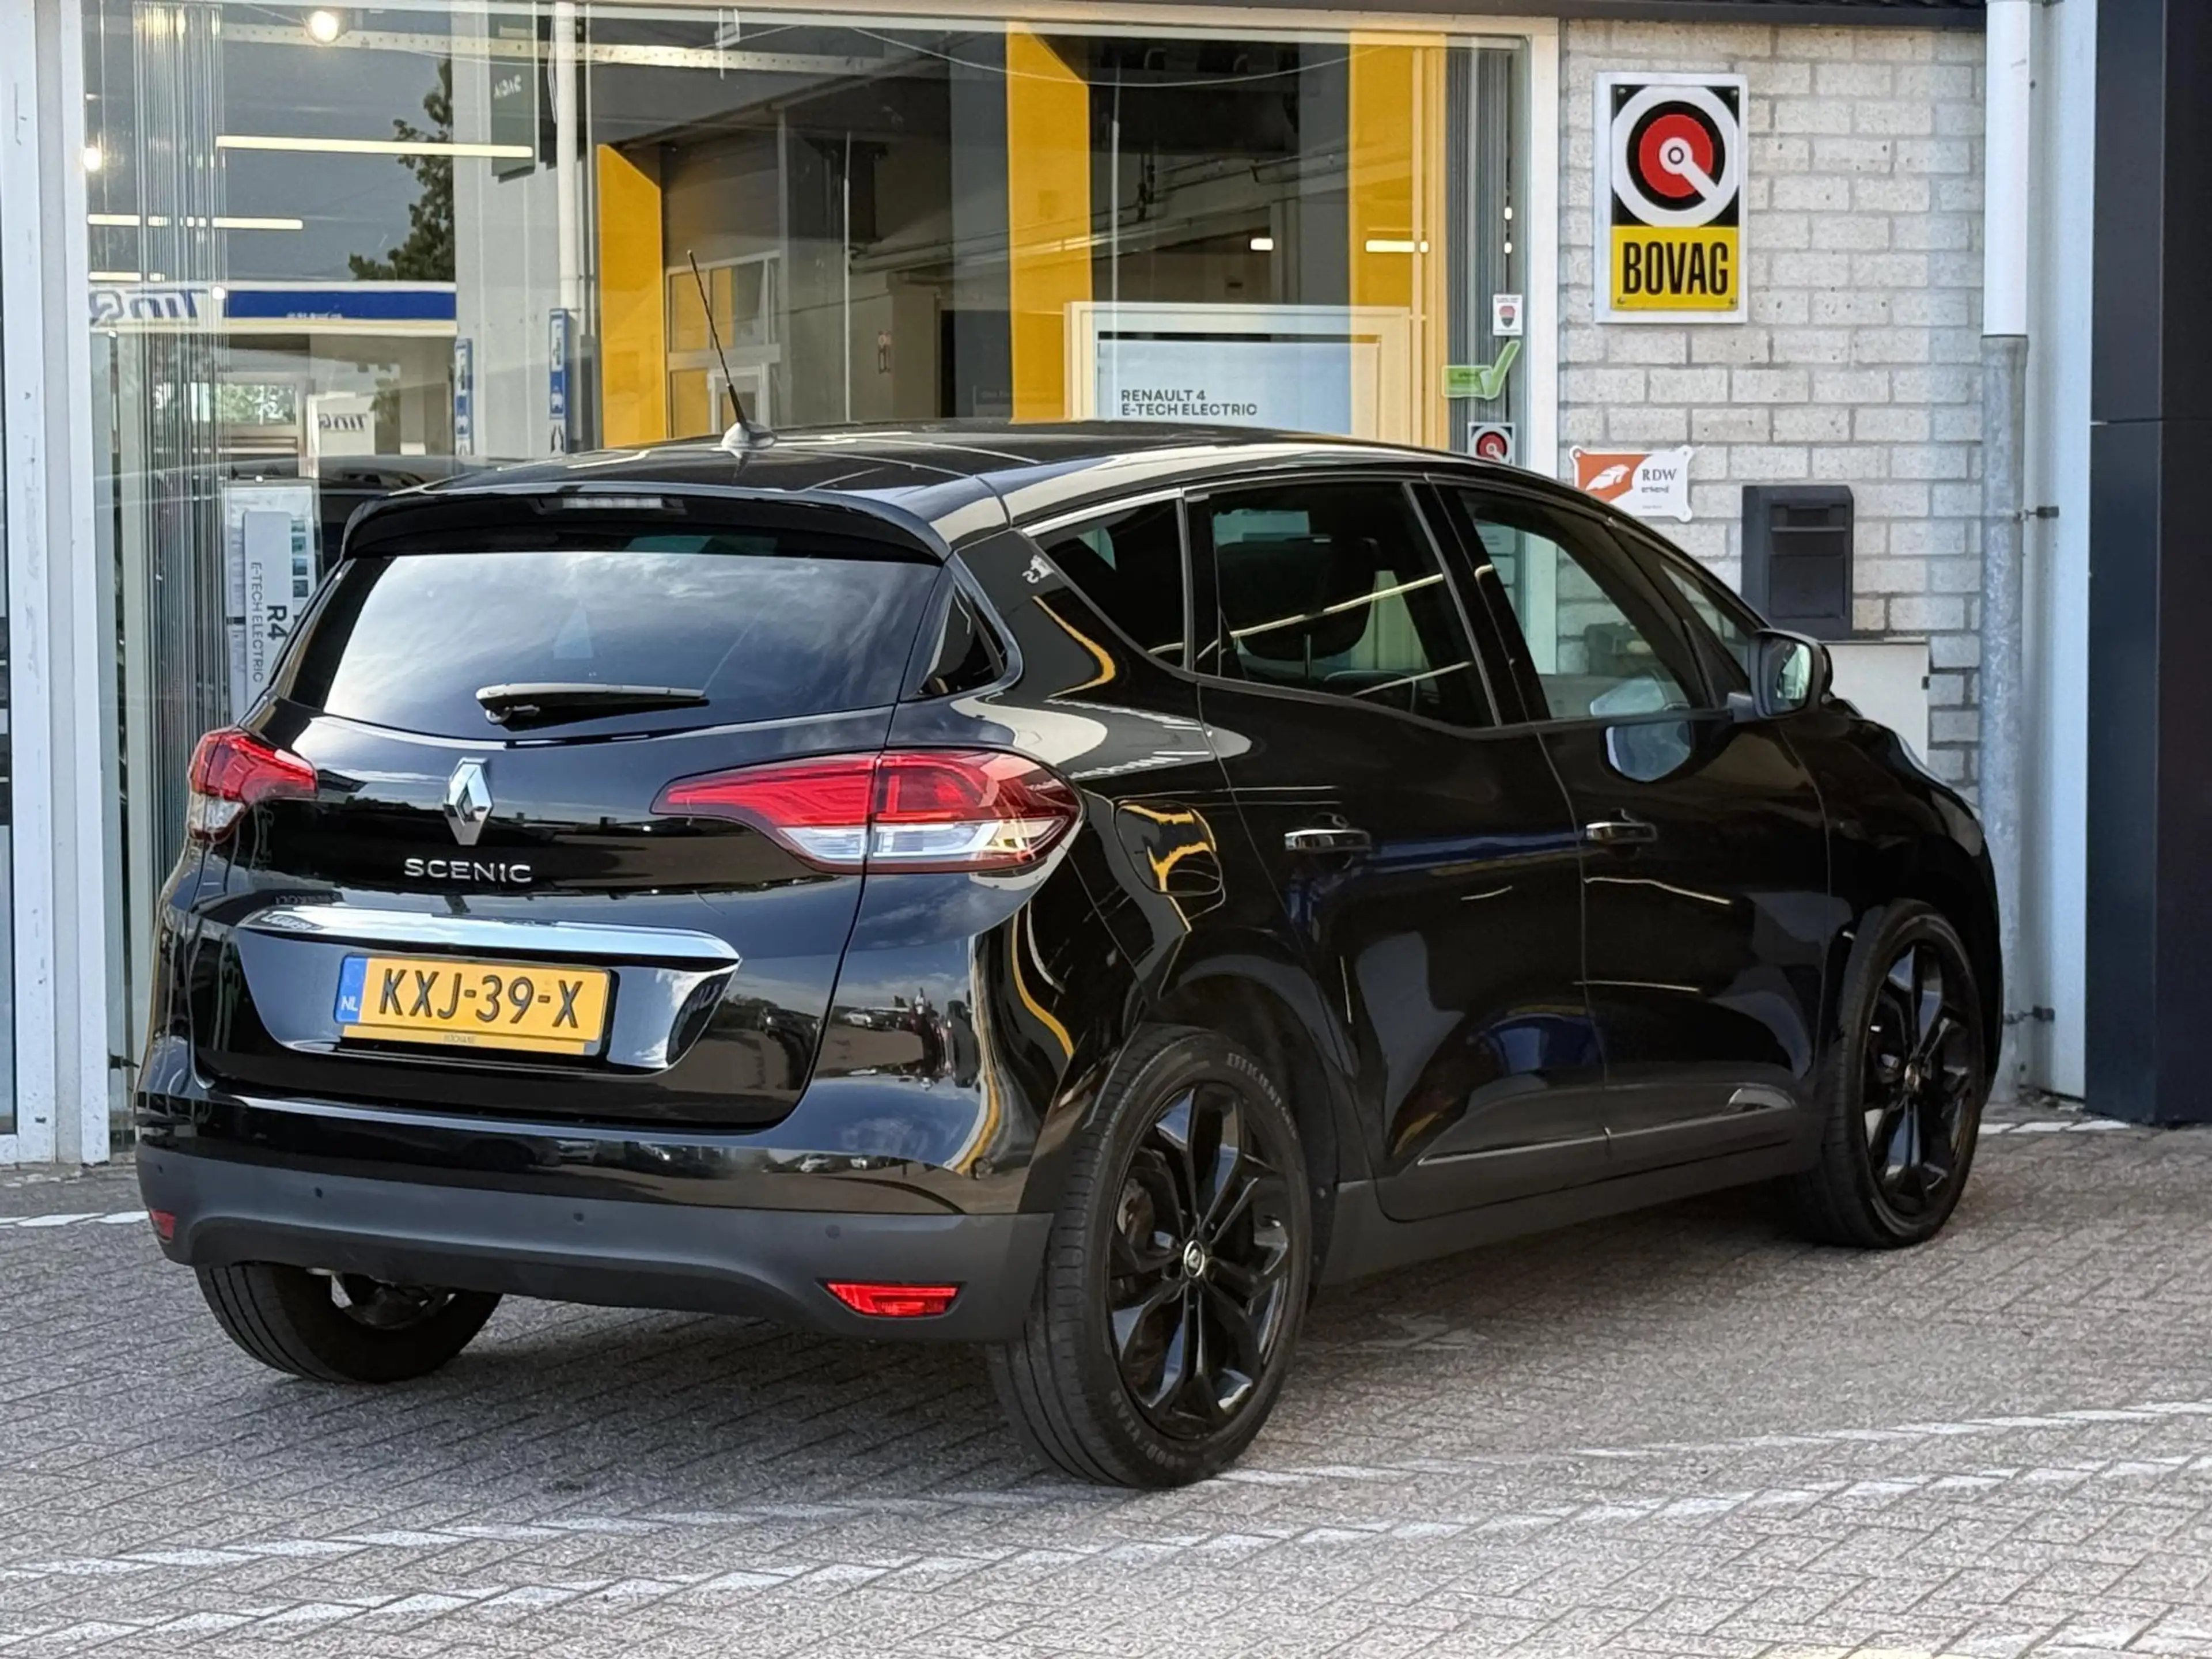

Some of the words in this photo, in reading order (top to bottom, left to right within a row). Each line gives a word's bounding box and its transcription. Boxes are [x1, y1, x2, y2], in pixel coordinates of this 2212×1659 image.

[1622, 241, 1728, 296] BOVAG
[1121, 389, 1193, 402] RENAULT
[1196, 390, 1206, 402] 4
[1122, 403, 1178, 416] E-TECH
[1181, 403, 1257, 416] ELECTRIC
[1642, 468, 1677, 481] RDW
[267, 605, 288, 641] R4
[252, 615, 263, 682] ELECTRIC
[404, 857, 533, 883] SCENIC
[340, 995, 359, 1012] NL
[379, 968, 584, 1029] KXJ-39-X
